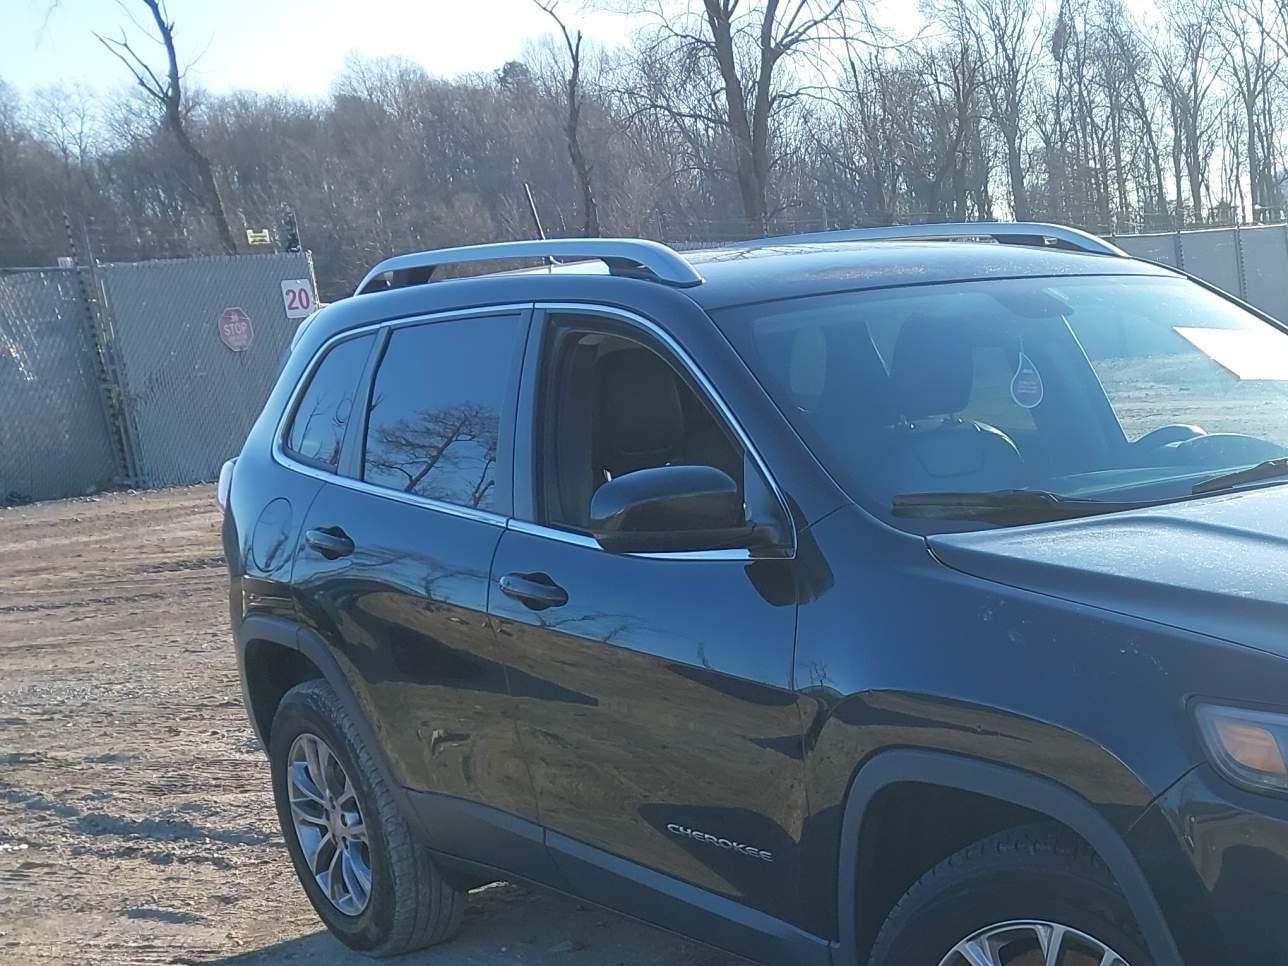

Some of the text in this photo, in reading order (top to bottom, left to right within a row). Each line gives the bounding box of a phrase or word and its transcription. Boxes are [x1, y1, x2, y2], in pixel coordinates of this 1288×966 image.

[285, 288, 310, 311] 20
[223, 322, 248, 337] STOP
[667, 824, 773, 862] CHEROKEE
